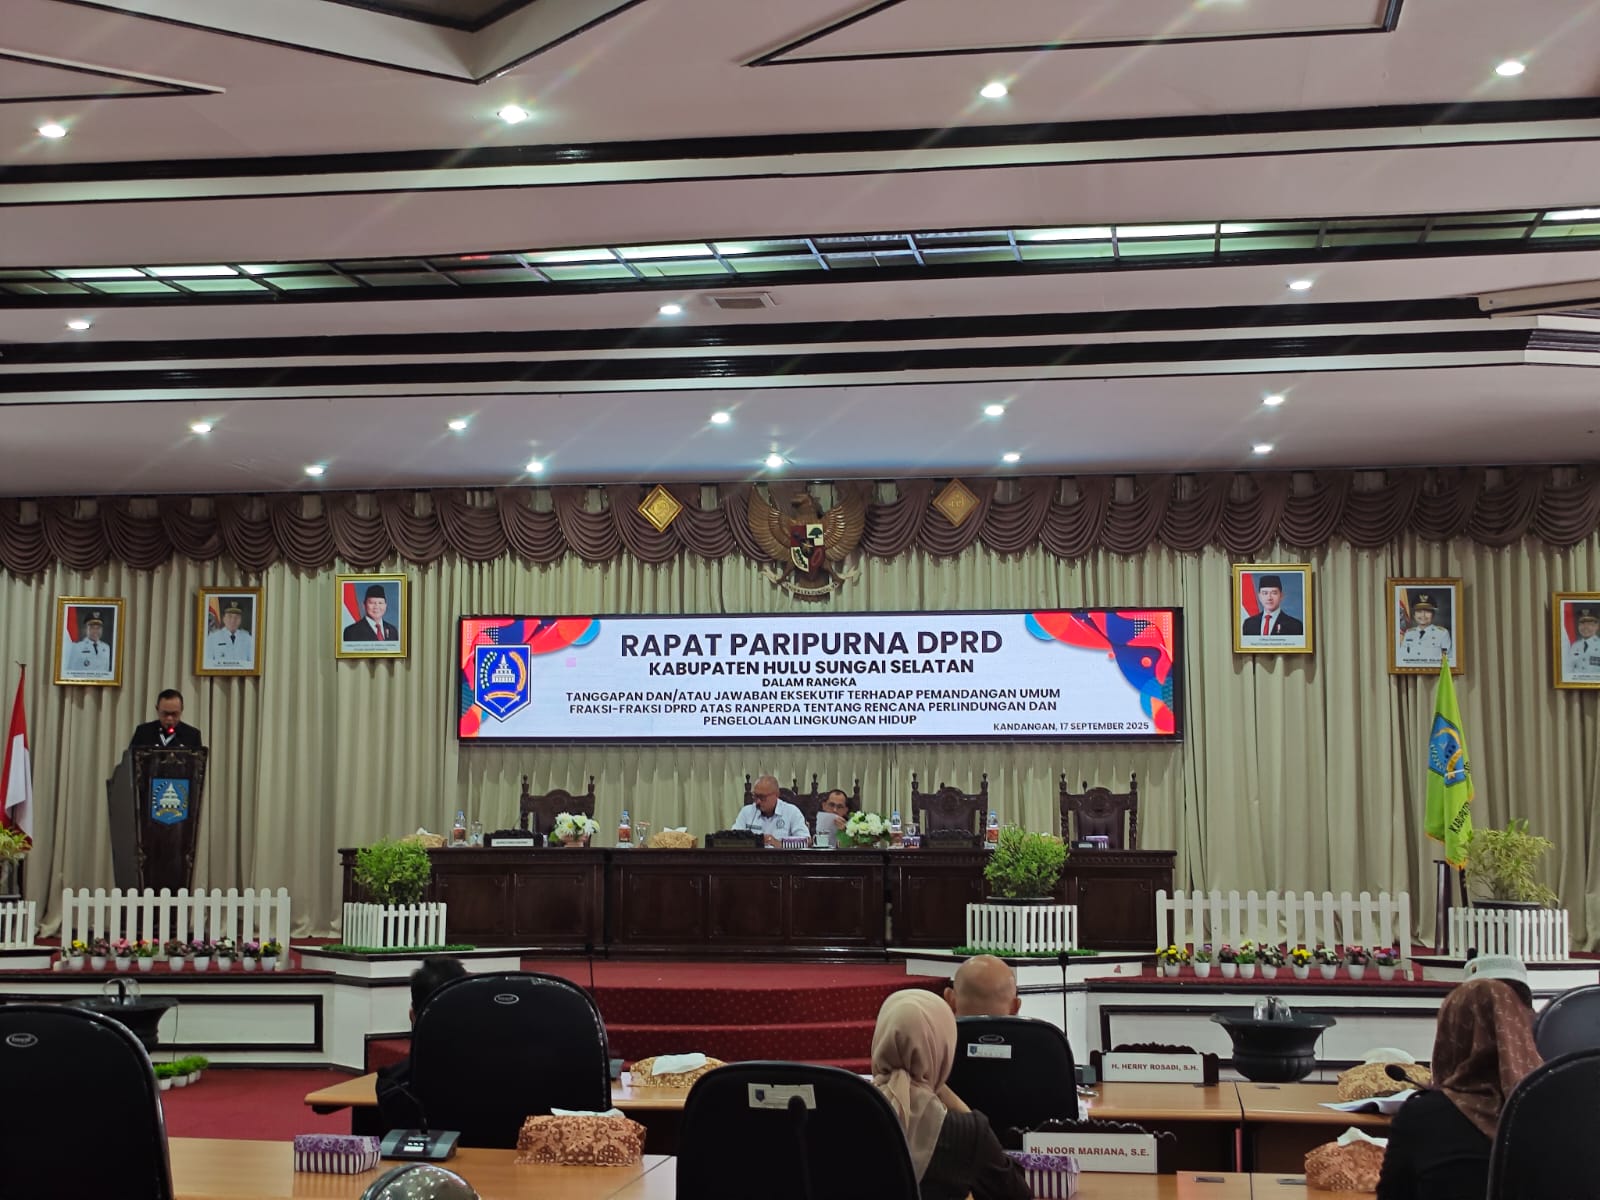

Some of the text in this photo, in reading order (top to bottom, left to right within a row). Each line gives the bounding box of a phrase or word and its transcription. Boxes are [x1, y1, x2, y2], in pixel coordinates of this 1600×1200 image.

[622, 630, 1003, 657] RAPAT PARIPURNA DPRD
[650, 659, 974, 675] KABUPATEN HULU SUNGAI SELATAN
[762, 678, 857, 687] DALAM RANGKA
[566, 688, 1061, 703] TANGGAPAN DAN/ATAU JAWABAN EKSEKUTIF TERHADAP PEMANDANGAN UMUM
[569, 701, 1057, 714] FRAKSI-FRAKSI DPRD ATAS RANPERDA TENTANG RENCANA PERLINDUNGAN DAN
[703, 714, 917, 726] PENGELOLAAN LINGKUNGAN HIDUP
[993, 721, 1149, 732] KANDANGAN, 17 SEPTEMBER 2025
[1149, 1063, 1182, 1071] ROSADI,
[1046, 1146, 1075, 1155] NOOR
[1078, 1147, 1128, 1157] MARIANA,
[1130, 1148, 1150, 1157] S.E.
